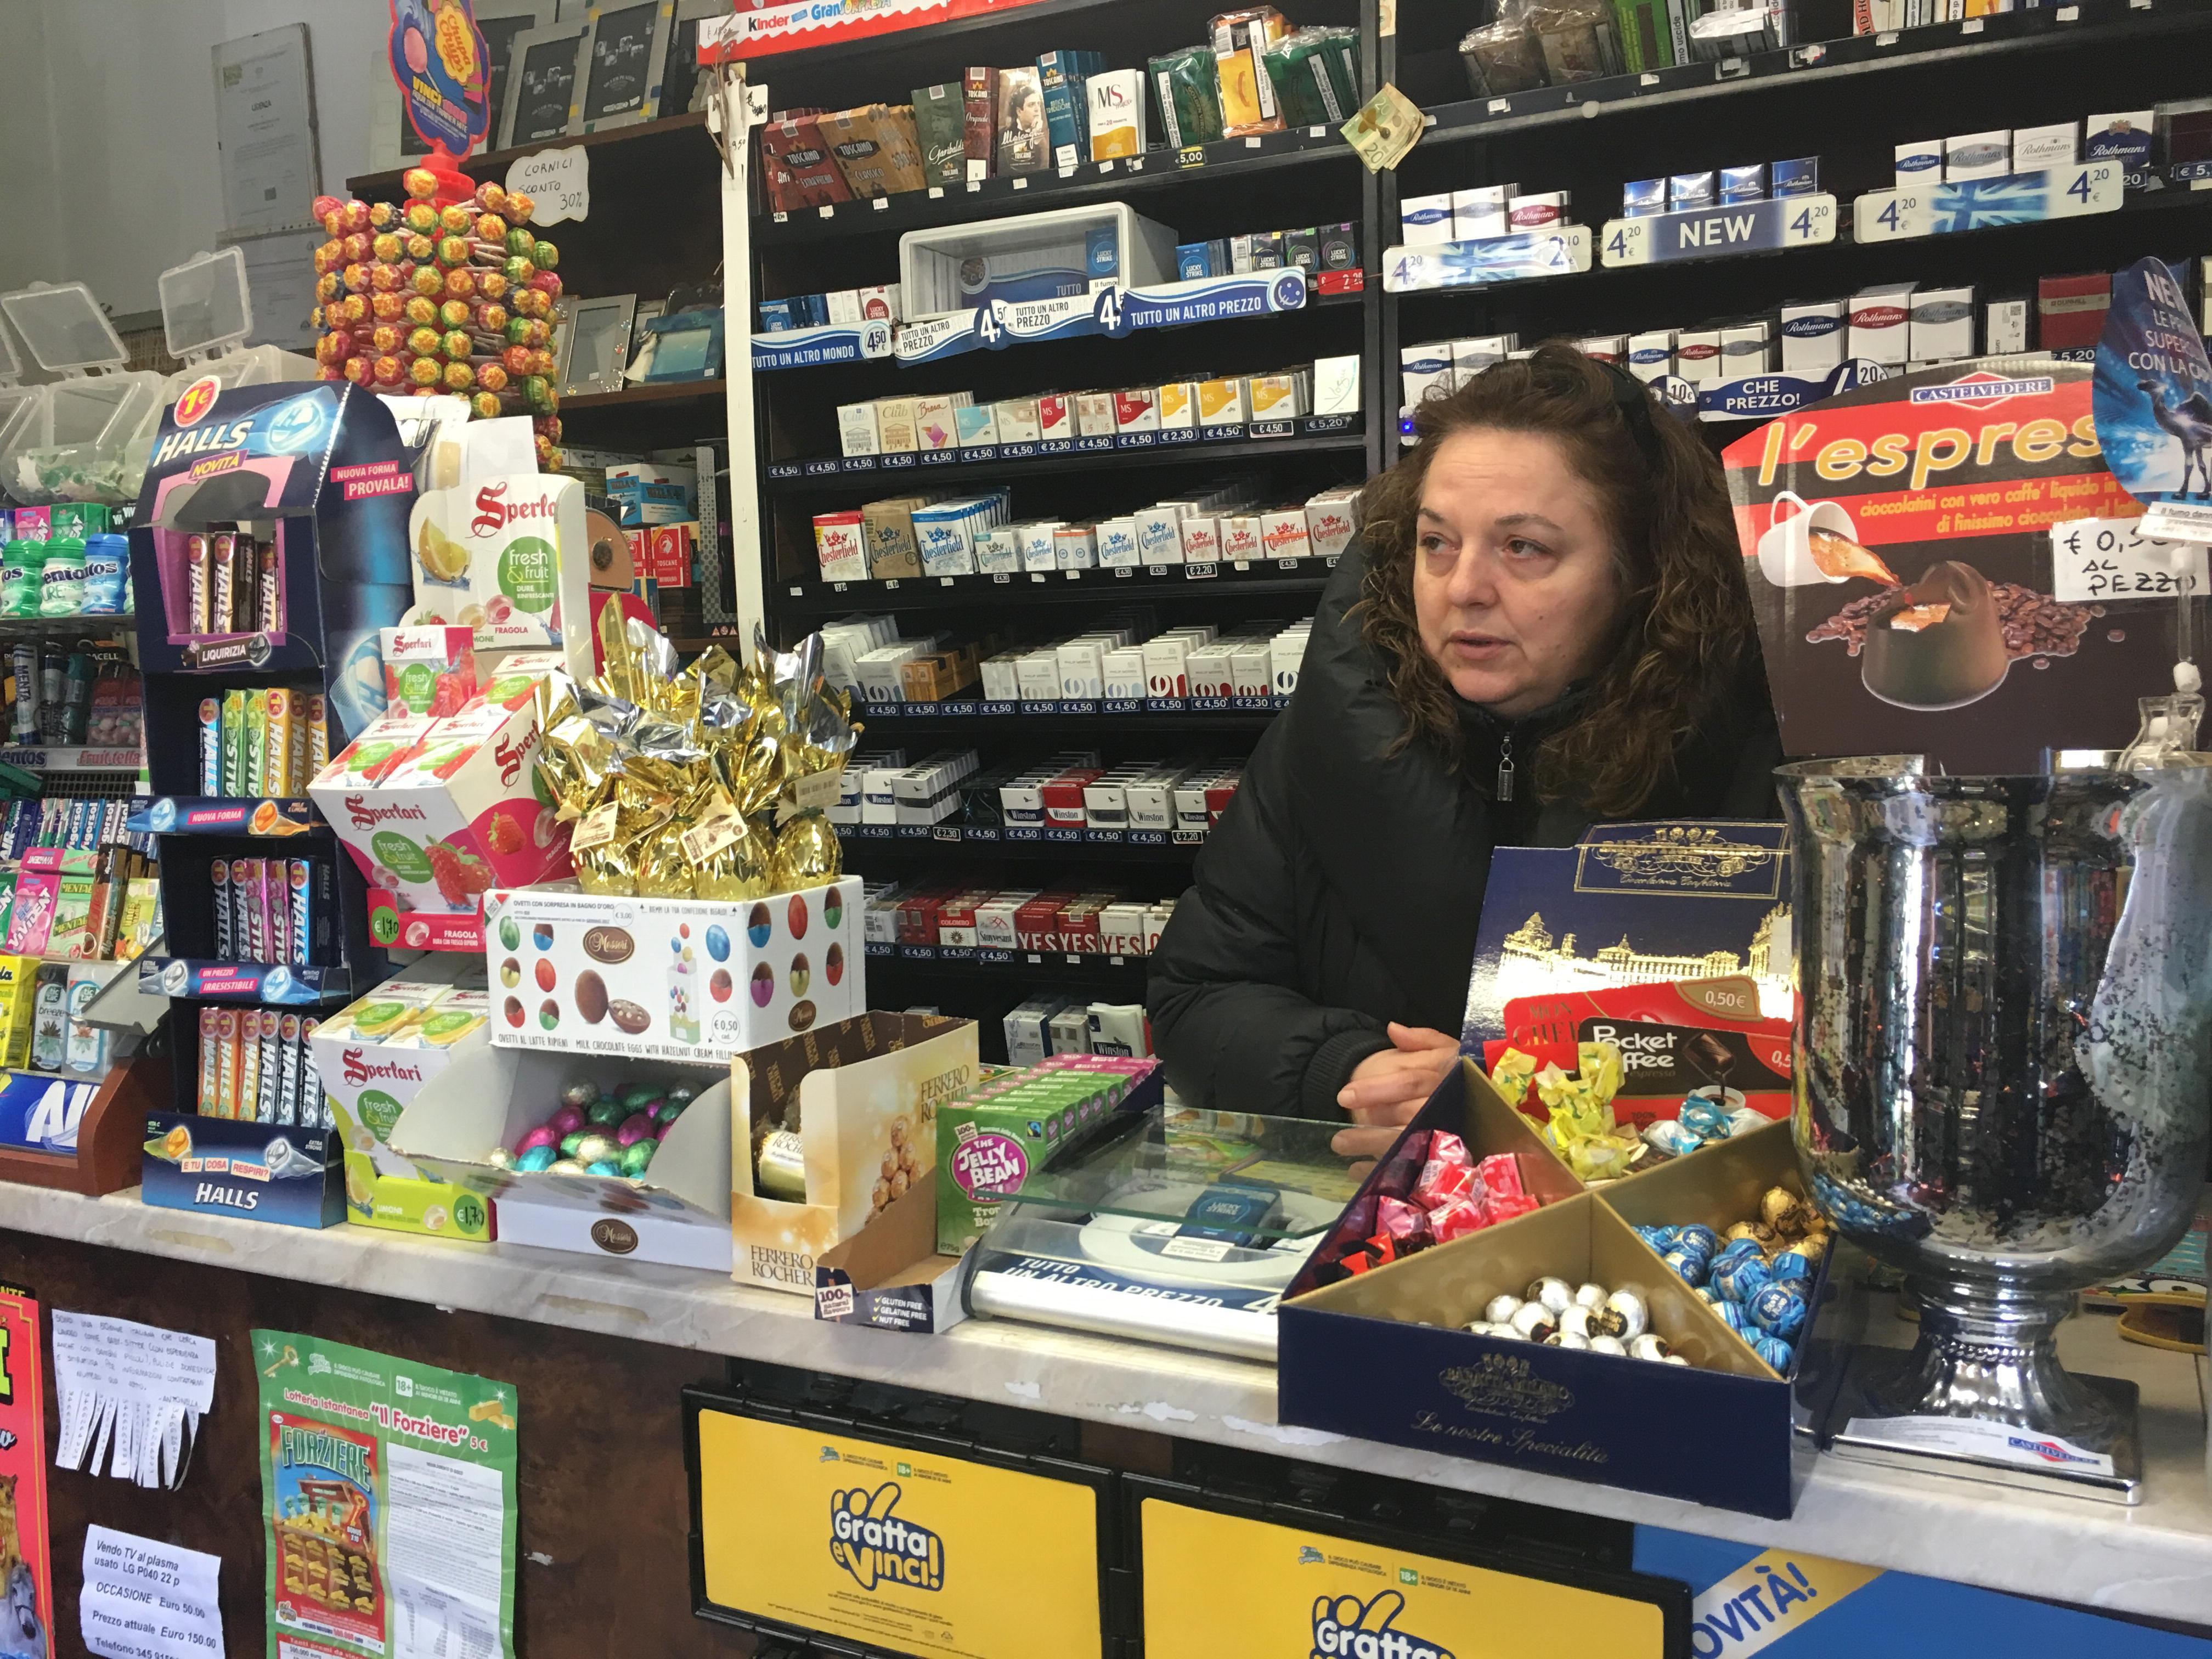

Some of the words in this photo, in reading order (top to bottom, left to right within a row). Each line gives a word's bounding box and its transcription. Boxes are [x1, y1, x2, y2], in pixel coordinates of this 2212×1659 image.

[748, 15, 789, 32] kinder
[440, 20, 464, 72] Chups
[448, 14, 471, 66] Chupa
[413, 75, 442, 106] VINCI
[1097, 84, 1123, 109] MS
[1374, 95, 1390, 116] 20
[787, 150, 820, 165] TOSCANO
[839, 141, 873, 156] TOSCANO
[1180, 152, 1203, 164] 5,00
[1363, 143, 1383, 164] 20
[2090, 143, 2146, 158] Rothmans
[524, 157, 573, 177] CORNICI
[1900, 156, 1936, 171] Rothmans
[518, 181, 561, 195] SCONTO
[560, 191, 583, 211] 30%
[1410, 211, 1442, 222] Rothmans
[1513, 208, 1555, 222] Rothmans
[1679, 213, 1756, 249] NEW
[1331, 249, 1346, 257] LUCKY
[1331, 253, 1347, 262] STRIKE
[1186, 265, 1203, 274] LUCKY
[1186, 269, 1203, 278] STRIKE
[870, 306, 884, 314] LUCKY
[870, 311, 887, 319] STRIKE
[1015, 306, 1036, 317] TUTTO
[1037, 305, 1047, 314] UN
[1048, 301, 1069, 313] ALTRO
[1131, 310, 1163, 326] TUTTO
[1165, 306, 1181, 322] UN
[1183, 301, 1216, 321] ALTRO
[1219, 296, 1262, 314] PREZZO
[1855, 312, 1903, 324] Rothmans
[1017, 314, 1050, 328] PREZZO
[1786, 320, 1834, 333] Rothmans
[901, 331, 919, 341] TUTTO
[920, 327, 930, 336] UN
[930, 321, 950, 334] ALTRO
[903, 336, 934, 353] PREZZO
[752, 356, 777, 368] TUTTO
[779, 353, 793, 364] UN
[794, 349, 820, 363] ALTRO
[822, 345, 854, 361] MONDO
[2129, 351, 2166, 370] CON
[1742, 380, 1779, 393] CHE
[1915, 378, 2053, 402] CASTELVEDERE
[1042, 407, 1053, 416] MS
[1120, 404, 1132, 414] MS
[1726, 394, 1801, 410] PREZZO!
[843, 408, 868, 423] Club
[882, 405, 908, 419] Club
[153, 420, 253, 466] HALLS
[193, 453, 241, 477] NOVITÀ
[336, 466, 365, 479] NUOVA
[366, 463, 397, 476] FORMA
[349, 475, 409, 495] PROVALA!
[1860, 494, 1937, 517] cioccolatini
[1940, 495, 1965, 509] con
[1970, 492, 2001, 507] vero
[1937, 515, 1949, 534] di
[1954, 512, 2013, 532] finissimo
[509, 548, 548, 565] fresh
[818, 541, 859, 568] Chesterfield
[870, 535, 912, 566] Chesterfield
[919, 536, 964, 565] Chesterfield
[1101, 540, 1135, 561] Chesterfield
[524, 563, 549, 579] fruit
[202, 645, 246, 662] LIQUIRIZIA
[393, 631, 432, 657] Sperlari
[193, 812, 216, 822] NUOVA
[217, 810, 241, 821] FORMA
[345, 794, 426, 831] Sperlari
[1053, 808, 1079, 820] Winston
[1137, 811, 1164, 823] Winston
[376, 839, 411, 853] fresh
[444, 930, 477, 939] FRAGOLA
[1018, 932, 1057, 952] YES
[1059, 932, 1096, 952] YES
[212, 968, 234, 977] PREZZO
[203, 980, 254, 991] IRRESISTIBILE
[1530, 1001, 1573, 1019] MON
[721, 1020, 738, 1032] 0,50
[498, 1034, 518, 1045] OVETTI
[520, 1035, 527, 1045] AL
[528, 1035, 545, 1046] LATTE
[546, 1037, 568, 1048] RIPIENI
[1592, 1024, 1678, 1051] Pocket
[575, 1039, 590, 1051] MILK
[592, 1040, 625, 1053] CHOCOLATE
[627, 1042, 643, 1054] EGGS
[645, 1043, 659, 1055] WITH
[661, 1045, 692, 1057] HAZELNUT
[693, 1047, 713, 1059] CREAM
[1096, 1043, 1130, 1058] Winston
[341, 1047, 423, 1088] Sperlari
[259, 1042, 276, 1116] HALLS
[280, 1045, 297, 1124] HALLS
[920, 1064, 969, 1098] FERRERO
[973, 1138, 994, 1148] THE
[957, 1142, 1008, 1172] JELLY
[183, 1161, 189, 1170] E
[191, 1161, 201, 1170] TU
[206, 1159, 227, 1169] COSA
[233, 1163, 269, 1178] RESPIRI?
[969, 1158, 1020, 1188] BEAN
[194, 1182, 259, 1211] HALLS
[751, 1245, 814, 1269] FERRERO
[752, 1262, 815, 1286] ROCHER
[882, 1297, 905, 1308] GLUTEN
[906, 1300, 922, 1310] FREE
[879, 1317, 893, 1325] NUT
[894, 1318, 910, 1327] FREE
[880, 1307, 909, 1318] GELATINE
[910, 1311, 927, 1321] FREE
[284, 1389, 319, 1407] Lotteria
[320, 1398, 369, 1420] Istantanea
[279, 1424, 371, 1492] FORZIERE
[835, 1510, 927, 1557] Gratta
[97, 1539, 122, 1557] Vendo
[124, 1547, 138, 1560] TV
[137, 1552, 146, 1562] al
[146, 1555, 179, 1572] plasma
[94, 1556, 119, 1570] usato
[122, 1562, 135, 1574] LG
[161, 1572, 171, 1584] 22
[96, 1581, 153, 1605] OCCASIONE
[159, 1596, 180, 1611] Euro
[183, 1603, 205, 1619] 50.00
[1692, 1562, 1818, 1659] OVITÀ!
[92, 1610, 122, 1627] Prezzo
[124, 1619, 156, 1634] attuale
[160, 1626, 185, 1641] Euro
[187, 1632, 217, 1649] 150.00
[94, 1637, 134, 1655] Telefono
